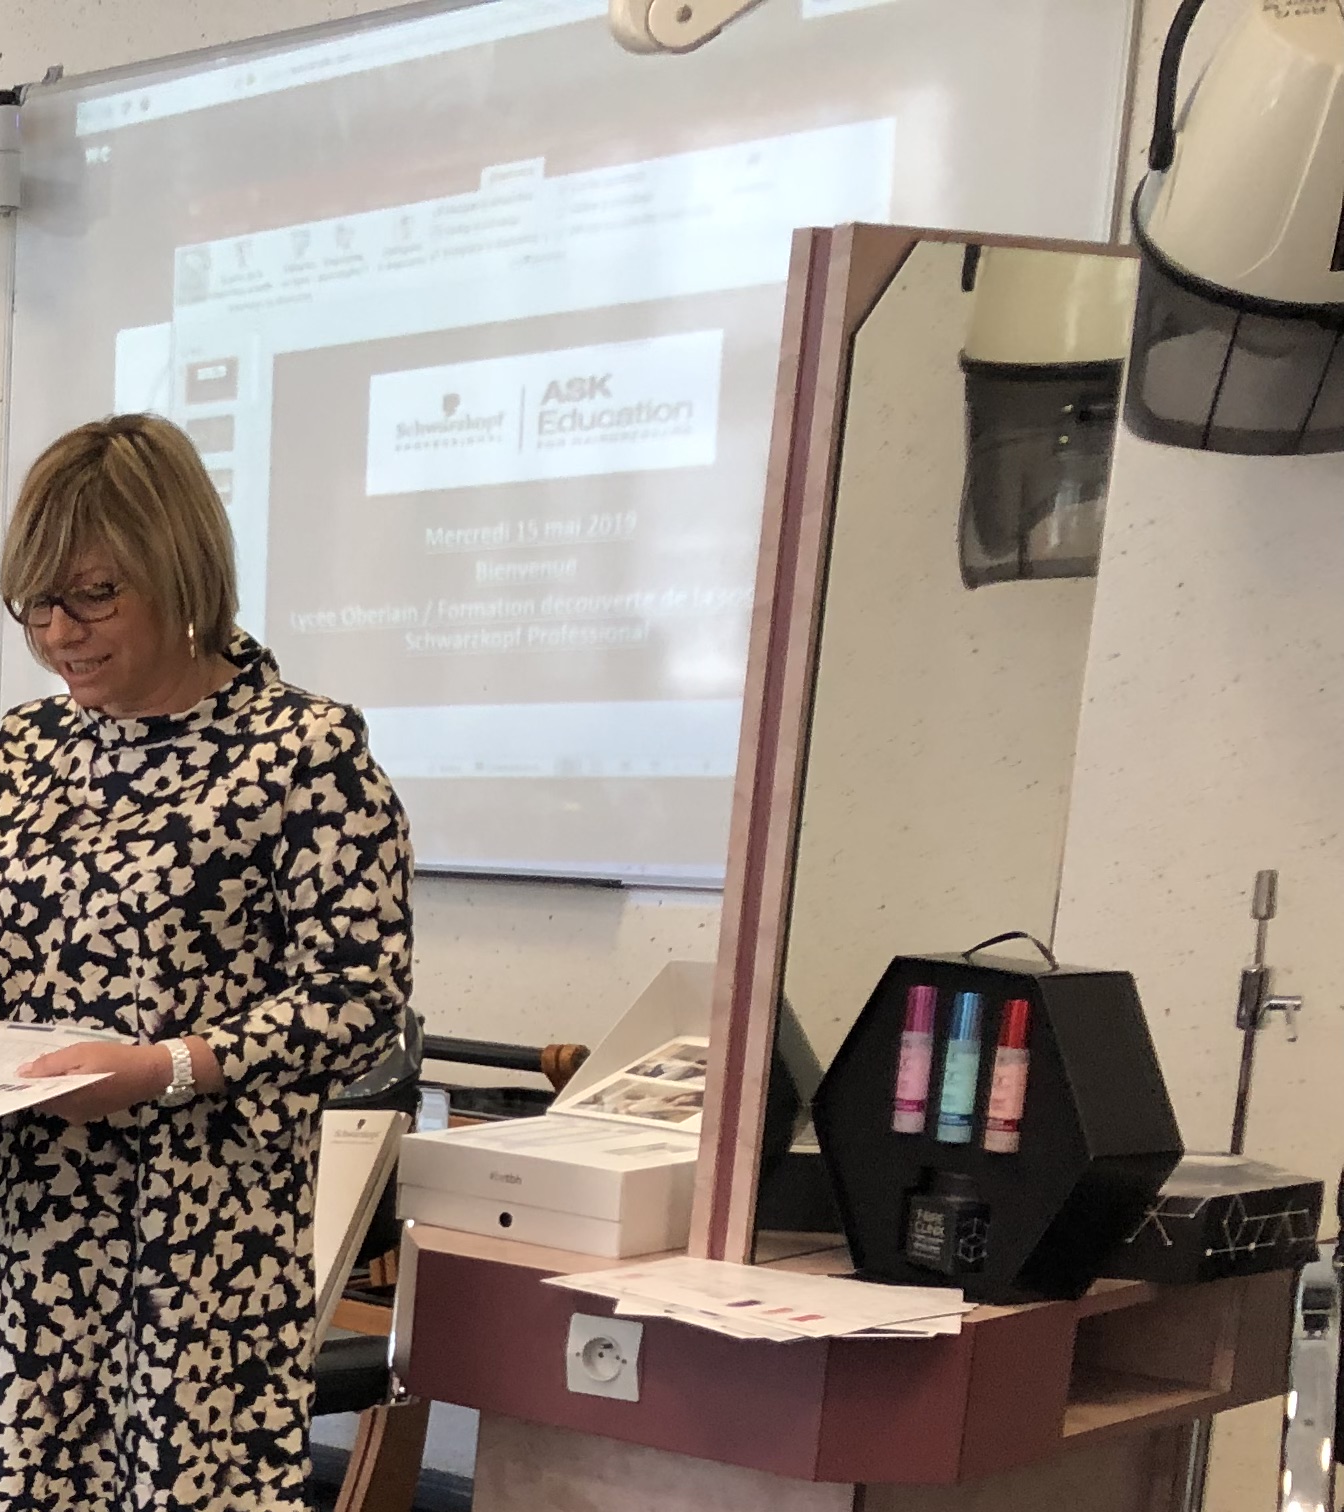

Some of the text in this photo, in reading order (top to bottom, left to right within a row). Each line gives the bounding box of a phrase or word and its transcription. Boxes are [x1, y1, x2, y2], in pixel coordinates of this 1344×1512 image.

[541, 372, 612, 406] ASK
[538, 399, 693, 436] Education
[425, 510, 638, 547] Mercredi 15 mai 2019
[474, 558, 578, 583] Bienvenue
[438, 596, 535, 621] Formation
